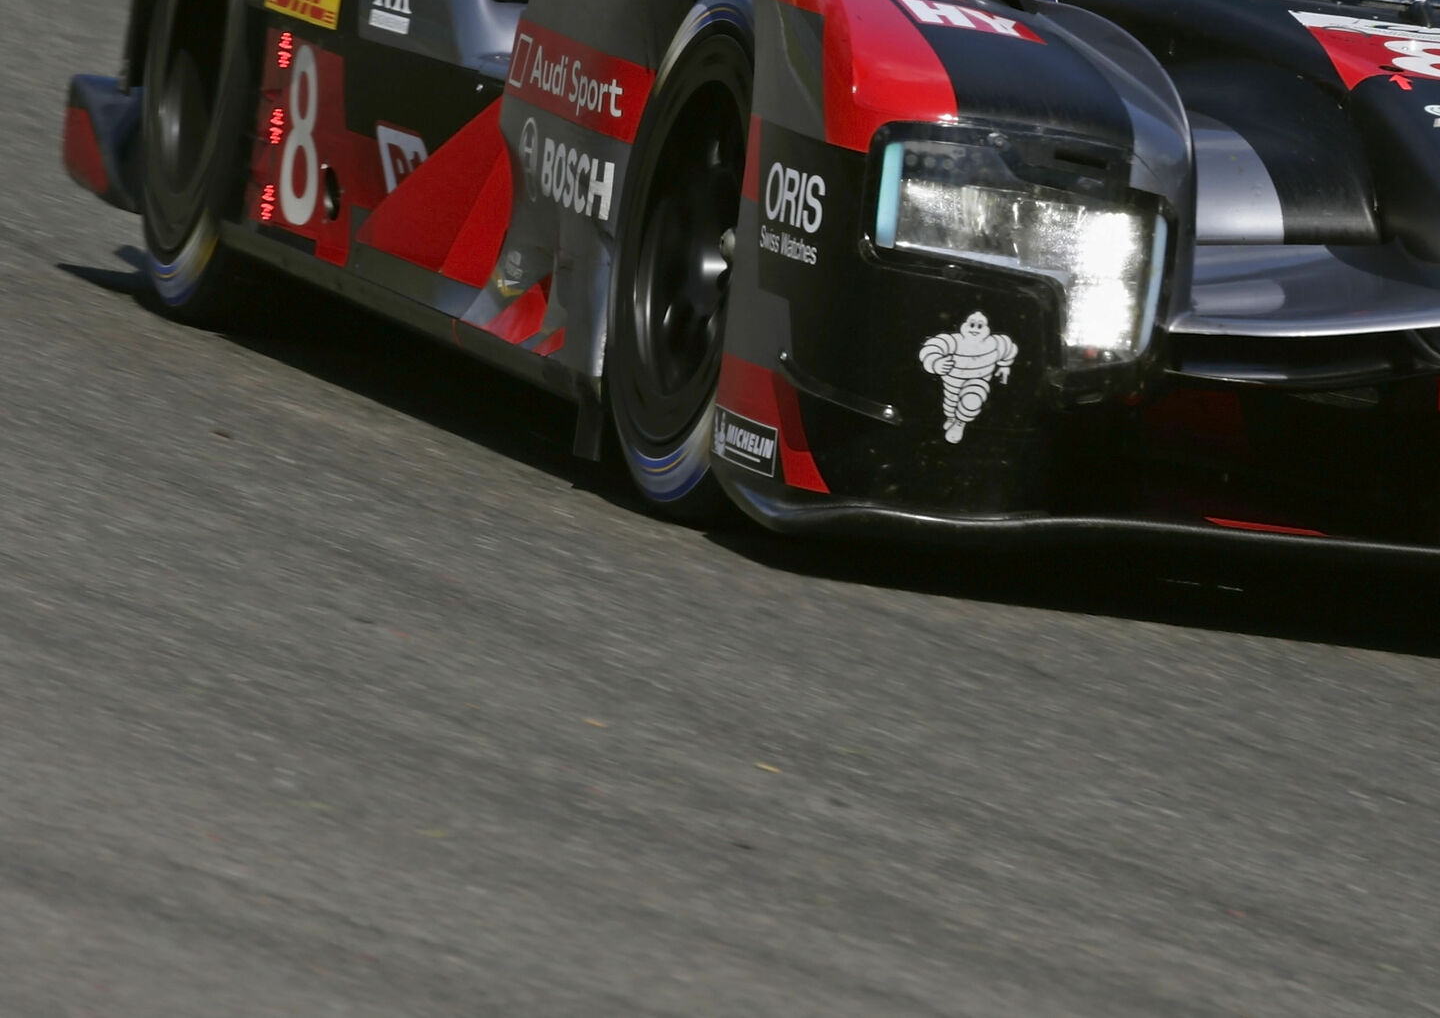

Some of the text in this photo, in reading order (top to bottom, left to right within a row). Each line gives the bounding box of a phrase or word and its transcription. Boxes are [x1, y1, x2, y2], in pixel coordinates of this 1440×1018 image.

[529, 45, 623, 118] Audi Sport
[279, 44, 319, 226] 8
[541, 137, 616, 222] BOSCH
[765, 161, 826, 233] ORIS
[760, 224, 818, 265] Swiss Watches
[726, 423, 774, 460] MICHELIN
